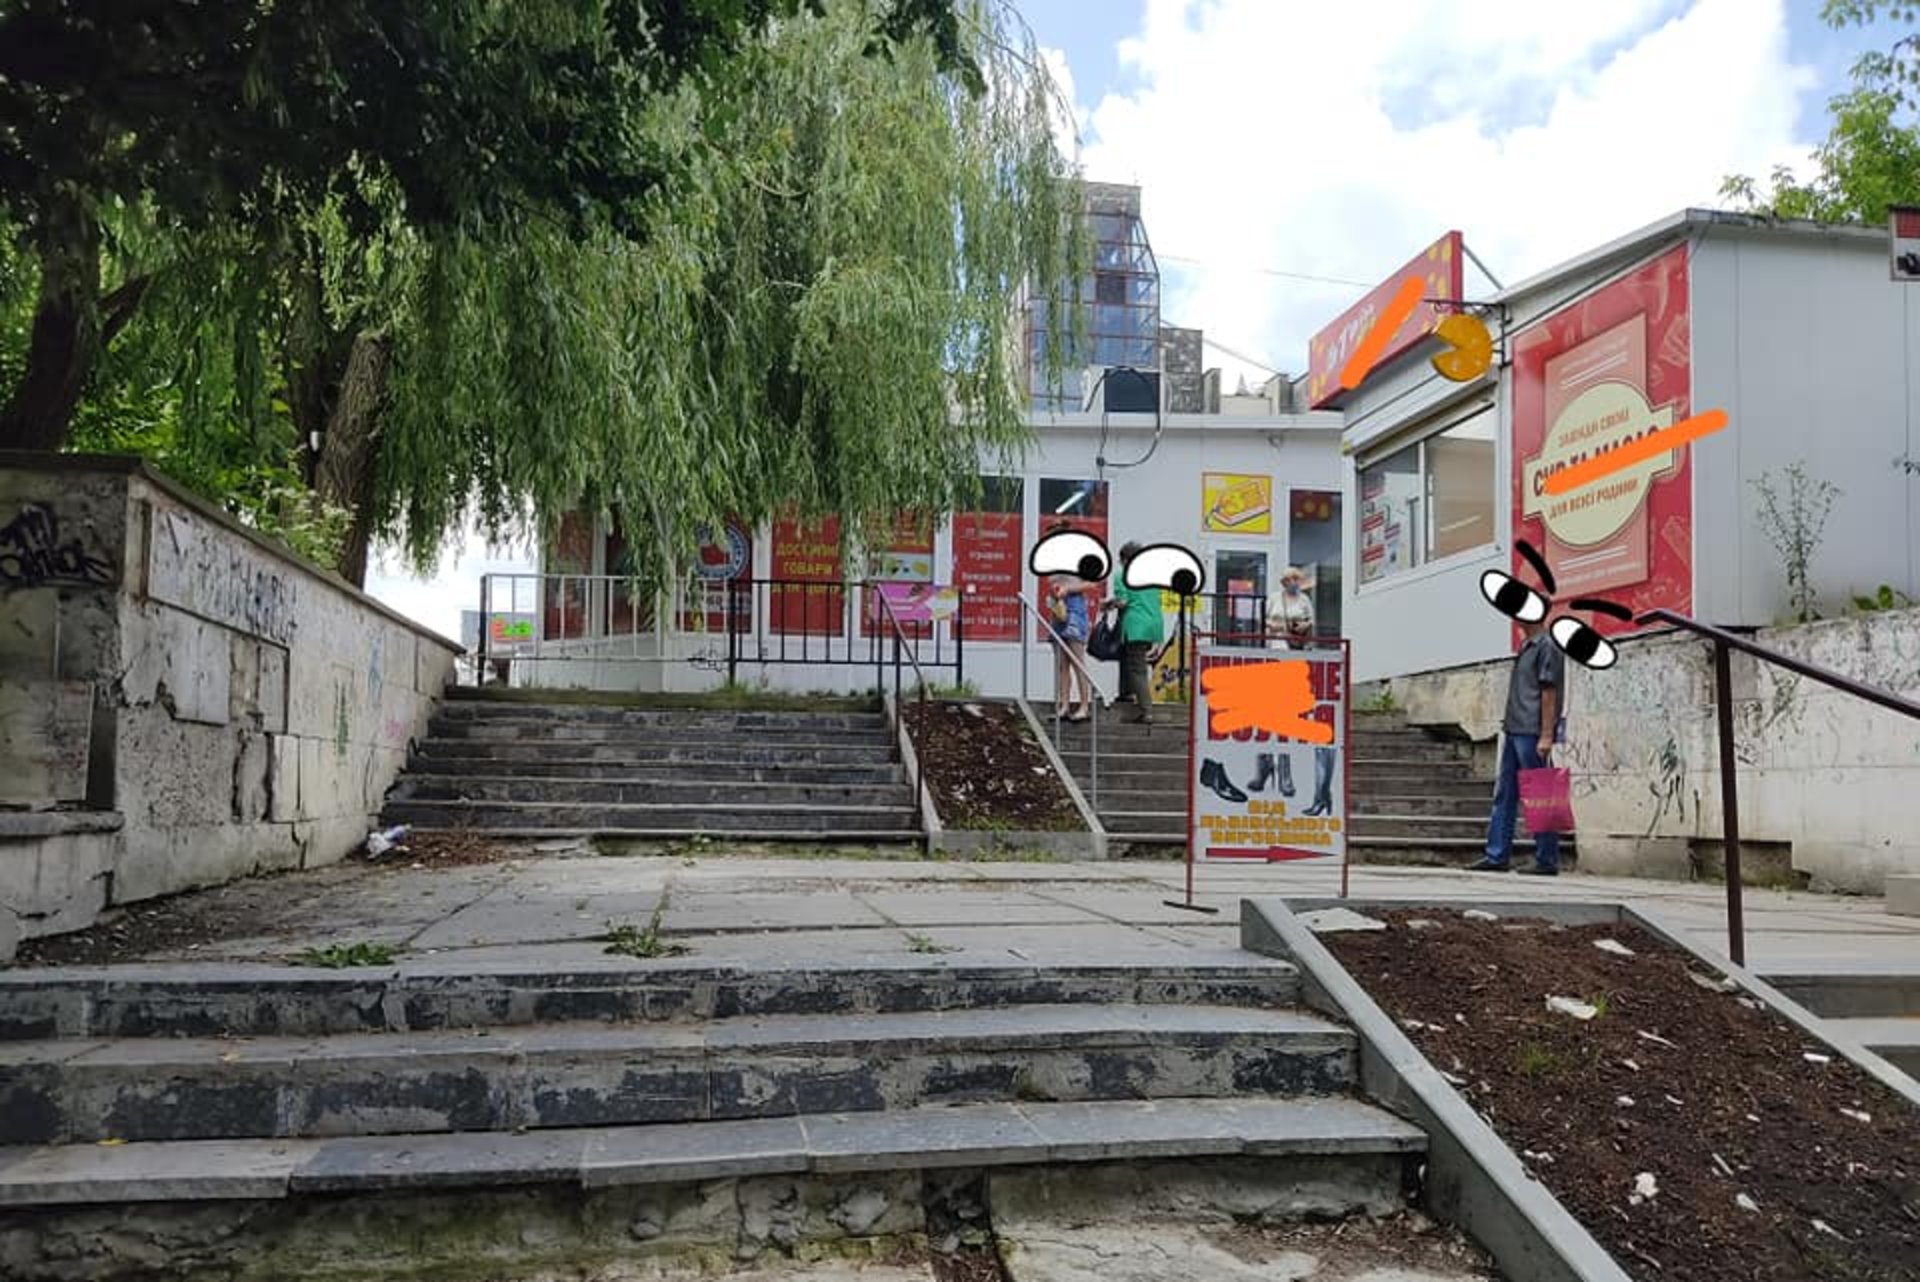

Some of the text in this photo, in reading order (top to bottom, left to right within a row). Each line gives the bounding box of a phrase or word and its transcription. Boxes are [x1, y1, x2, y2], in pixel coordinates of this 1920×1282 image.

[1550, 499, 1568, 518] ДЛЯ
[1597, 478, 1638, 503] РОДИНИ
[1248, 800, 1286, 816] ВІД
[1210, 831, 1333, 845] ВИРОБНИКА
